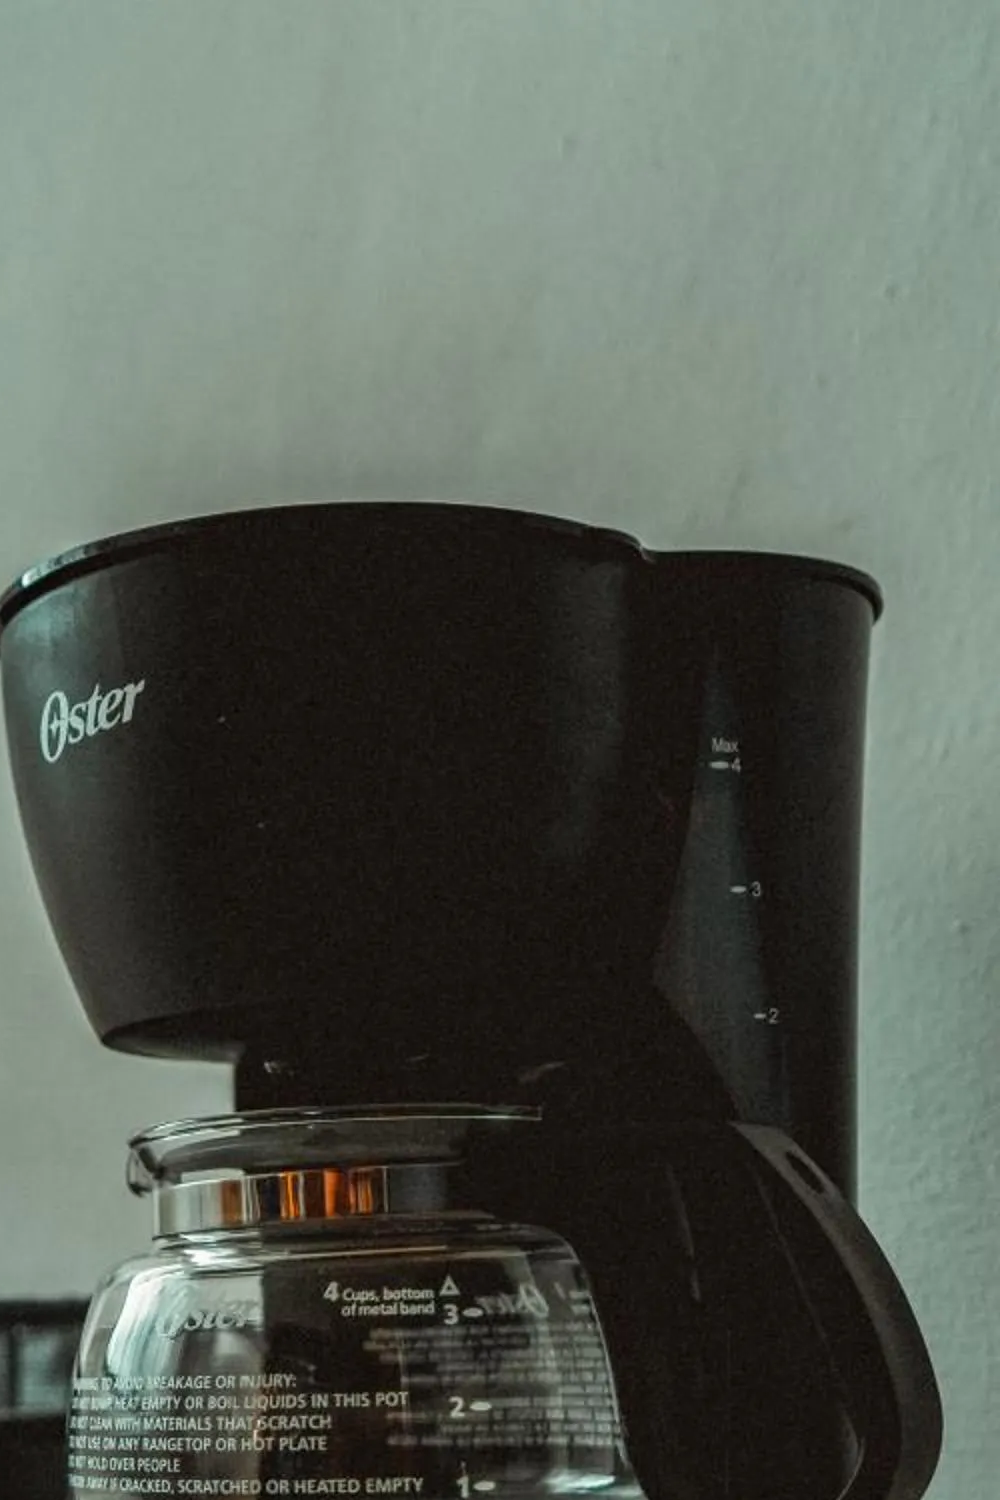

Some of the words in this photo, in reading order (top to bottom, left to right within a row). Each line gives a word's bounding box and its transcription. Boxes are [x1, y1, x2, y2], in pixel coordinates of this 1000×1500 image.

[40, 679, 145, 763] Oster
[711, 737, 739, 753] Max
[751, 881, 761, 897] 3
[768, 1007, 779, 1024] 2
[323, 1281, 339, 1300] 4
[342, 1287, 380, 1303] Cups,
[383, 1286, 435, 1300] bottom
[341, 1302, 356, 1317] of
[358, 1302, 397, 1315] metal
[400, 1301, 435, 1315] band
[443, 1304, 459, 1325] 3
[215, 1375, 236, 1390] OR
[239, 1373, 297, 1389] INJURY:
[142, 1396, 181, 1411] EMPTY
[184, 1397, 203, 1410] OR
[207, 1396, 240, 1409] BOIL
[244, 1393, 307, 1411] LIQUIDS
[311, 1394, 329, 1409] IN
[334, 1393, 370, 1408] THIS
[375, 1391, 409, 1407] POT
[448, 1396, 465, 1418] 2
[143, 1416, 212, 1431] MATERIALS
[216, 1416, 253, 1430] THAT
[257, 1415, 332, 1430] SCRATCH
[142, 1436, 211, 1452] RANGETOP
[215, 1437, 236, 1451] OR
[241, 1436, 274, 1451] HOT
[279, 1436, 328, 1451] PLATE
[137, 1457, 181, 1473] PEOPLE
[119, 1478, 175, 1495] CRACKED,
[178, 1478, 261, 1495] SCRATCHED
[265, 1479, 290, 1495] OR
[294, 1478, 361, 1494] HEATED
[365, 1477, 424, 1493] EMPTY
[456, 1475, 469, 1498] 1
